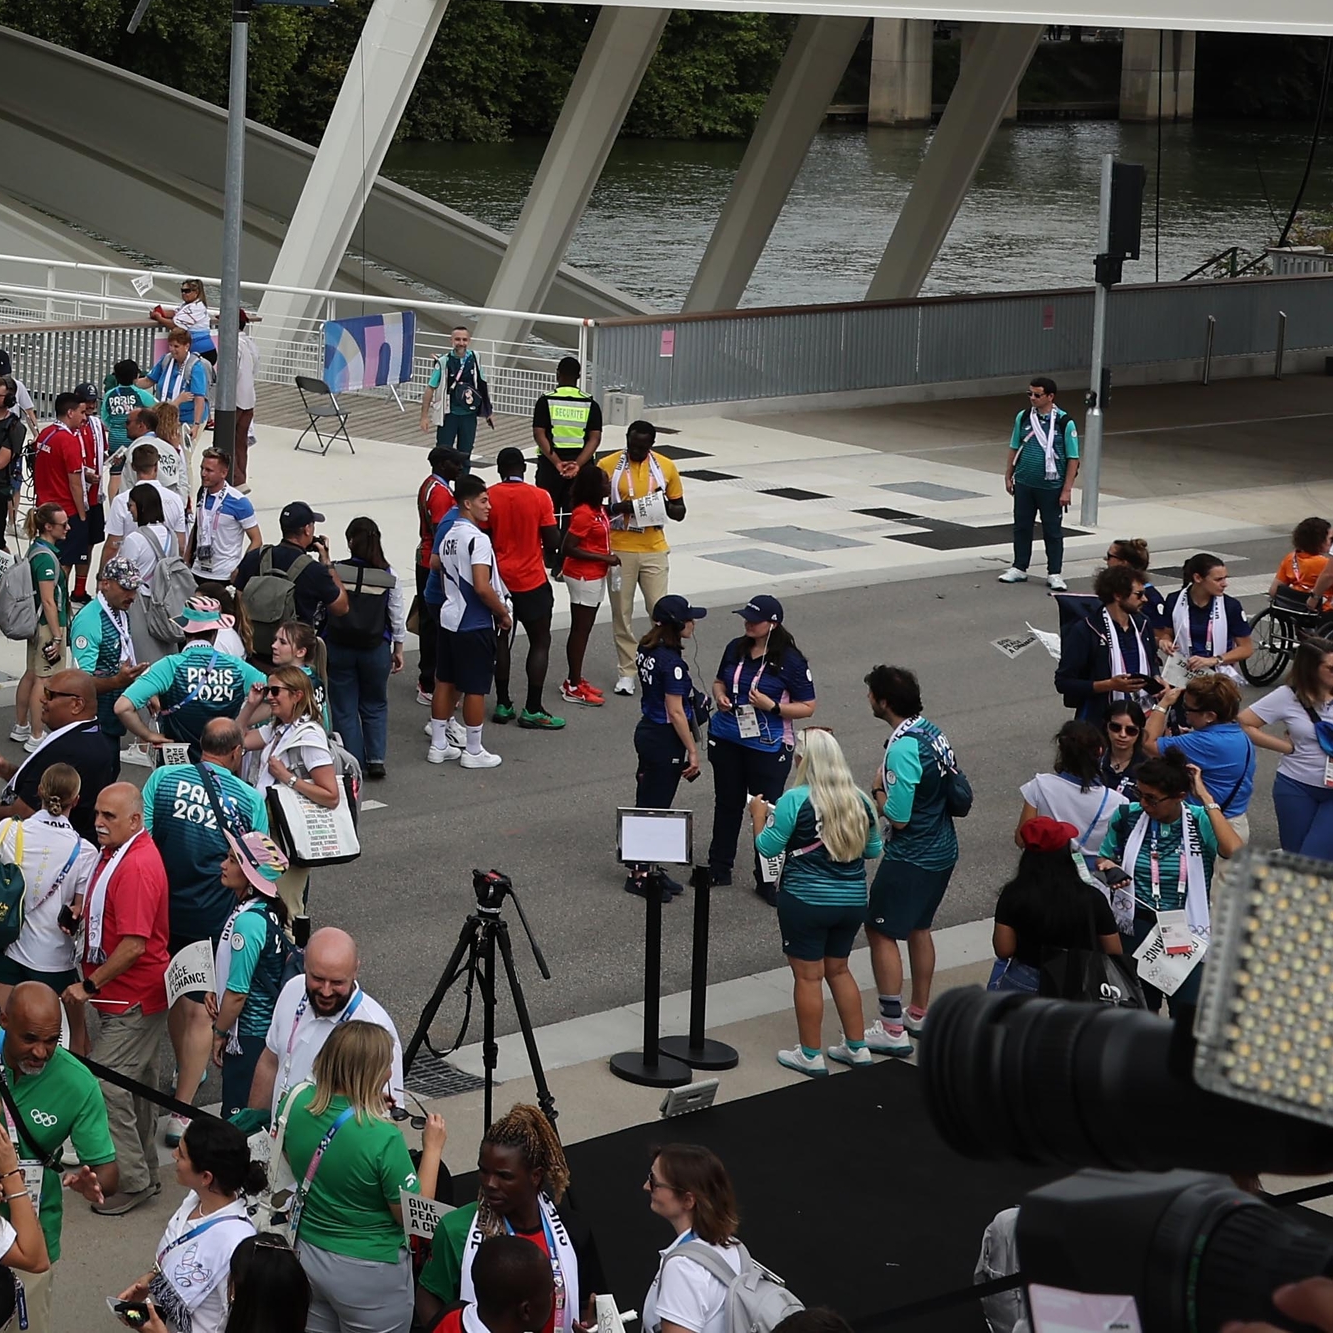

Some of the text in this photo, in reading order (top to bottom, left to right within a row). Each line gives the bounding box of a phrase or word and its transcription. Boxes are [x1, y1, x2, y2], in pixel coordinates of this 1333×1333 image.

[174, 972, 207, 992] CHANCE
[408, 1197, 437, 1214] GIVE
[410, 1208, 441, 1225] PEAC
[411, 1219, 420, 1230] A
